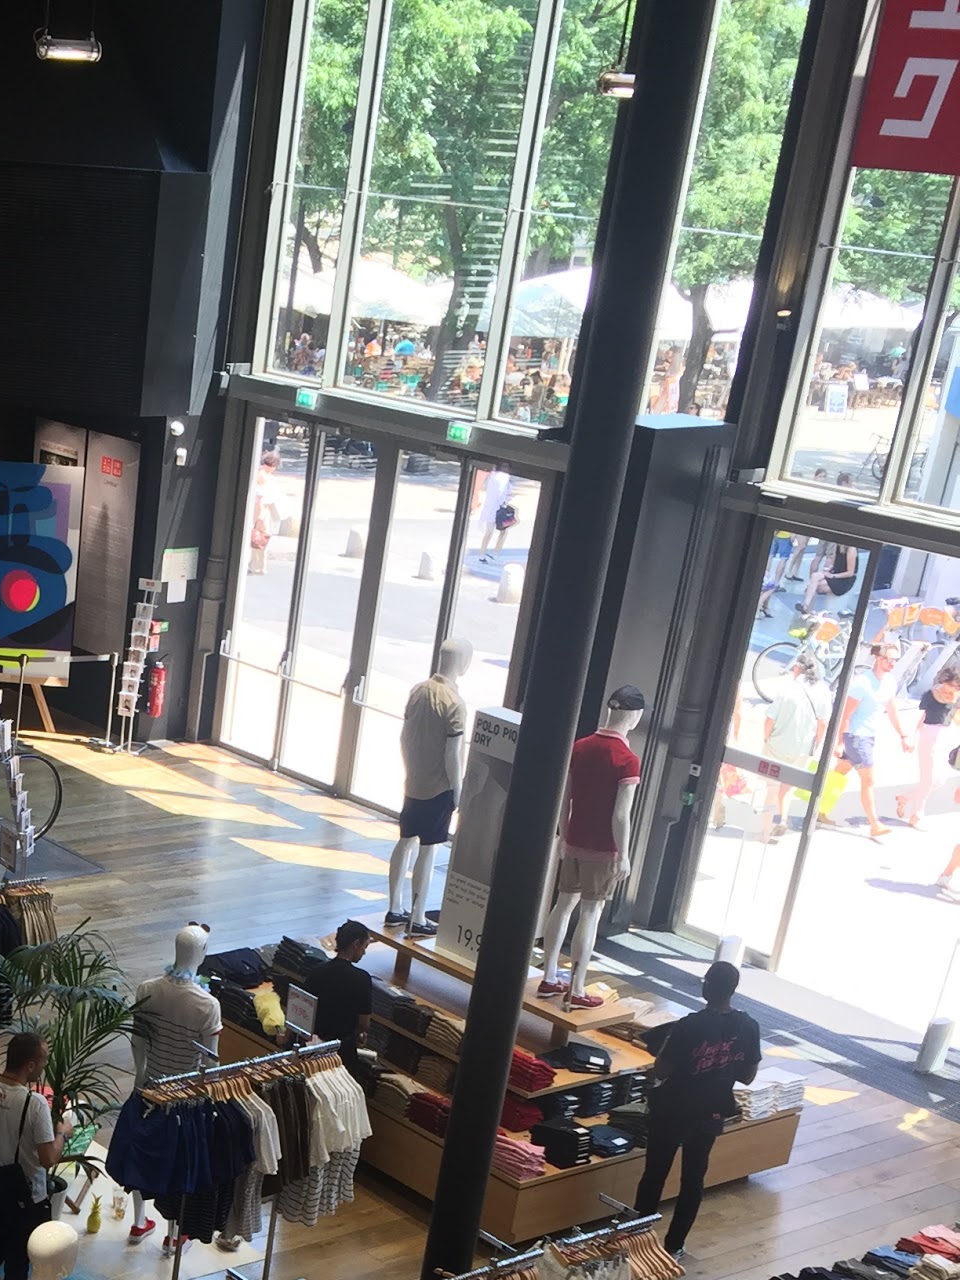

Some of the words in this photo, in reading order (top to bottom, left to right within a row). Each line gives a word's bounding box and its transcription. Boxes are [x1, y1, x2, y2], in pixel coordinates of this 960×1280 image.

[473, 731, 492, 748] DRY
[476, 718, 500, 736] POLO
[502, 726, 518, 744] PIQ
[457, 924, 482, 953] 19.9
